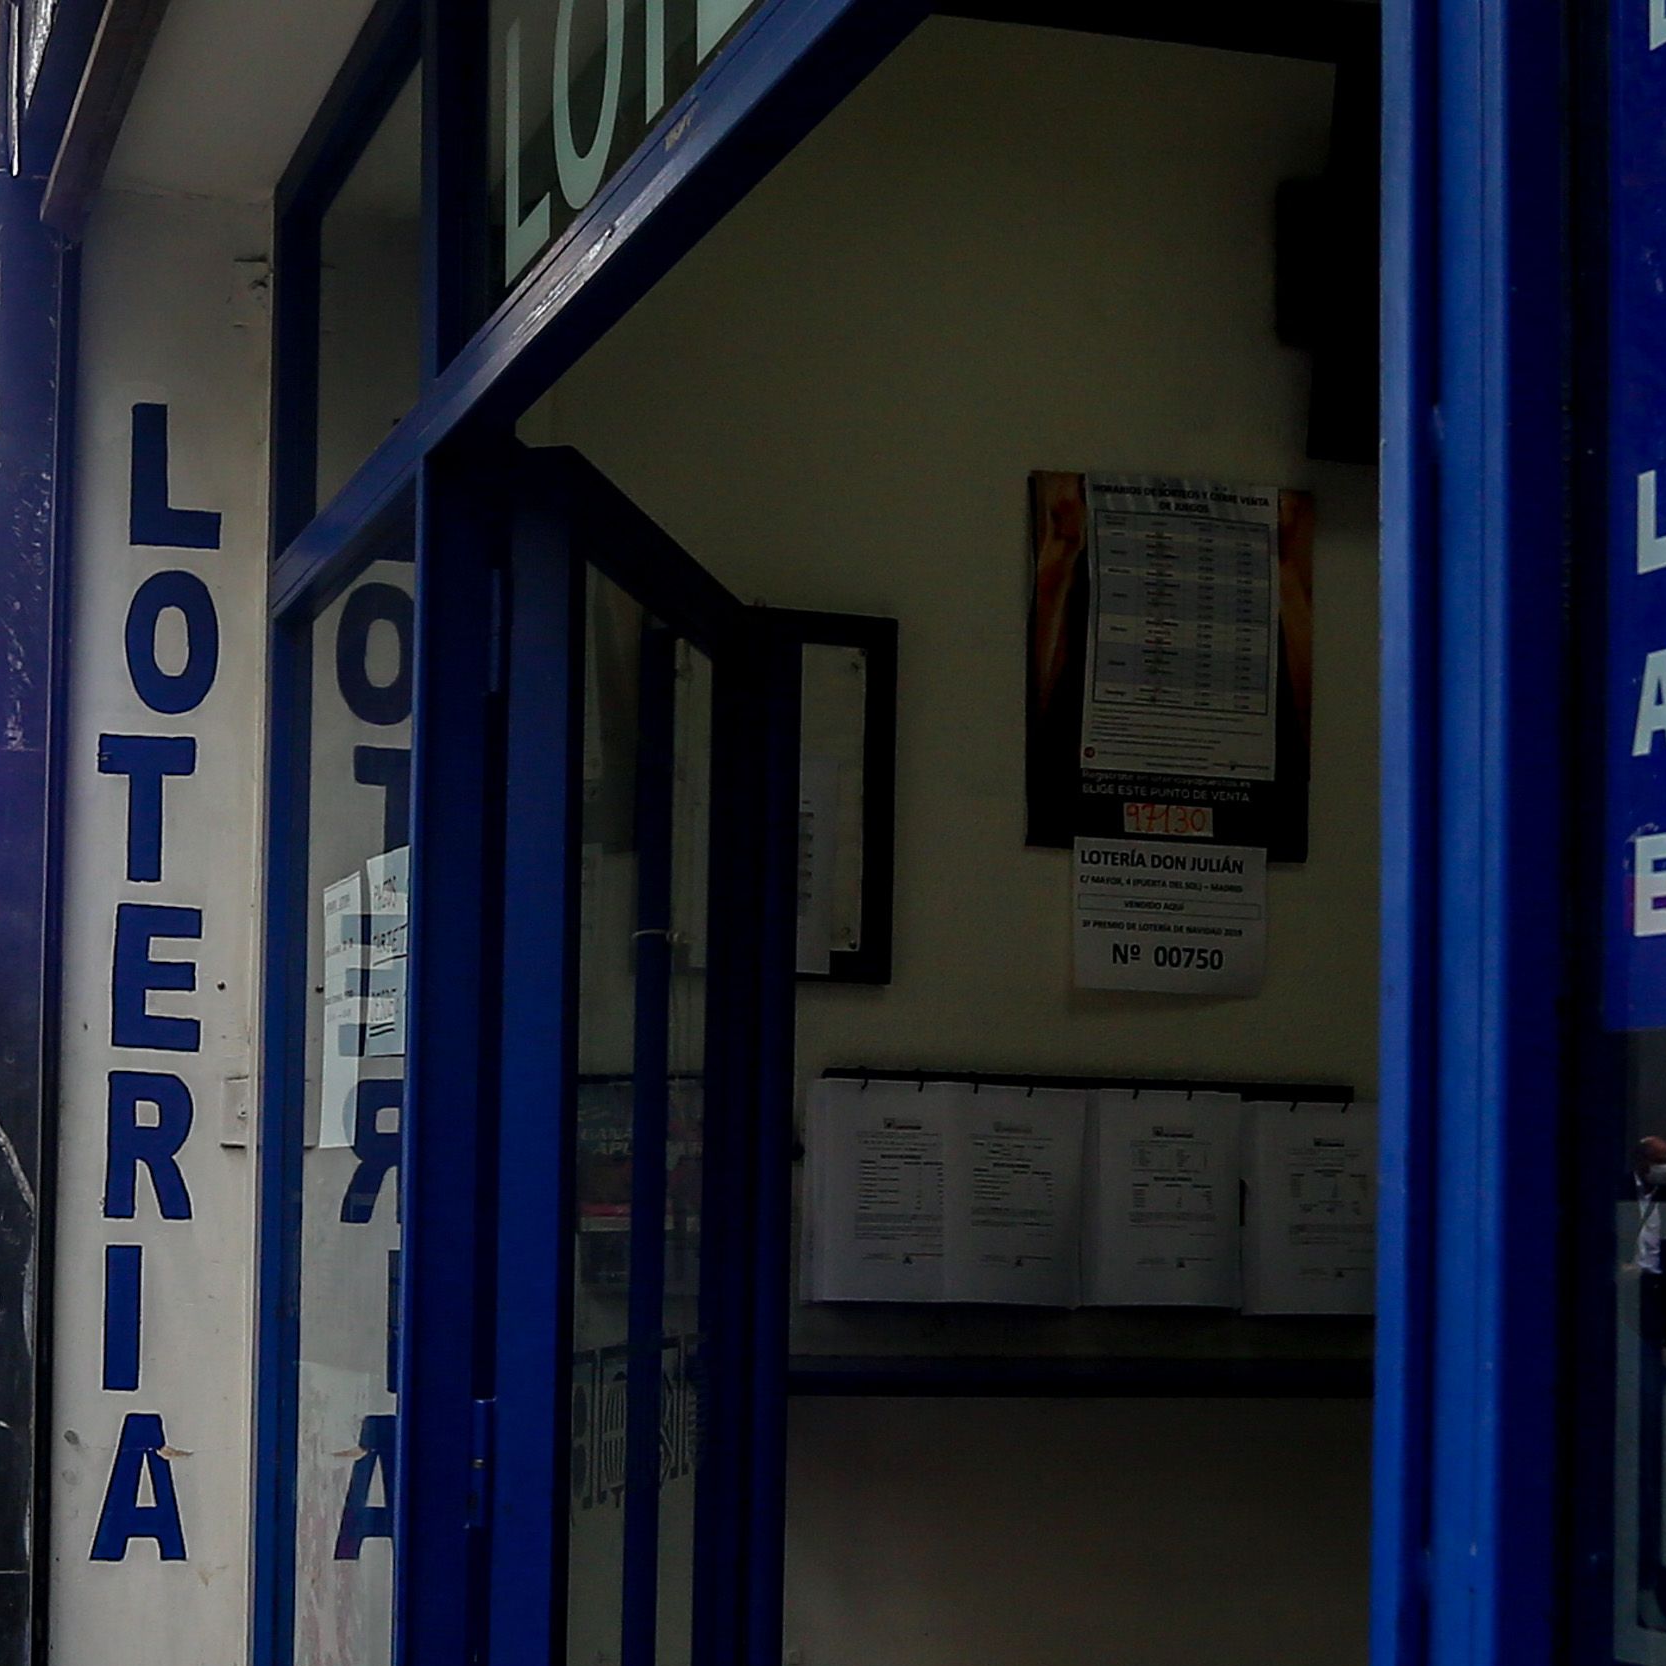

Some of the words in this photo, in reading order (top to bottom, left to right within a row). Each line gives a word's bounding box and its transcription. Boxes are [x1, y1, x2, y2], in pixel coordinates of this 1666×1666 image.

[1240, 494, 1270, 507] VENTA
[1117, 784, 1149, 797] ESTE
[1150, 786, 1191, 800] PUNTO
[1193, 790, 1208, 801] DE
[1211, 791, 1250, 803] VENTA
[1081, 849, 1147, 868] LOTERÍA
[1152, 854, 1187, 871] DON
[1190, 855, 1244, 874] JULIÁN
[1112, 943, 1141, 965] Nº
[1153, 945, 1224, 970] 00750
[89, 403, 222, 1562] LOTERIA
